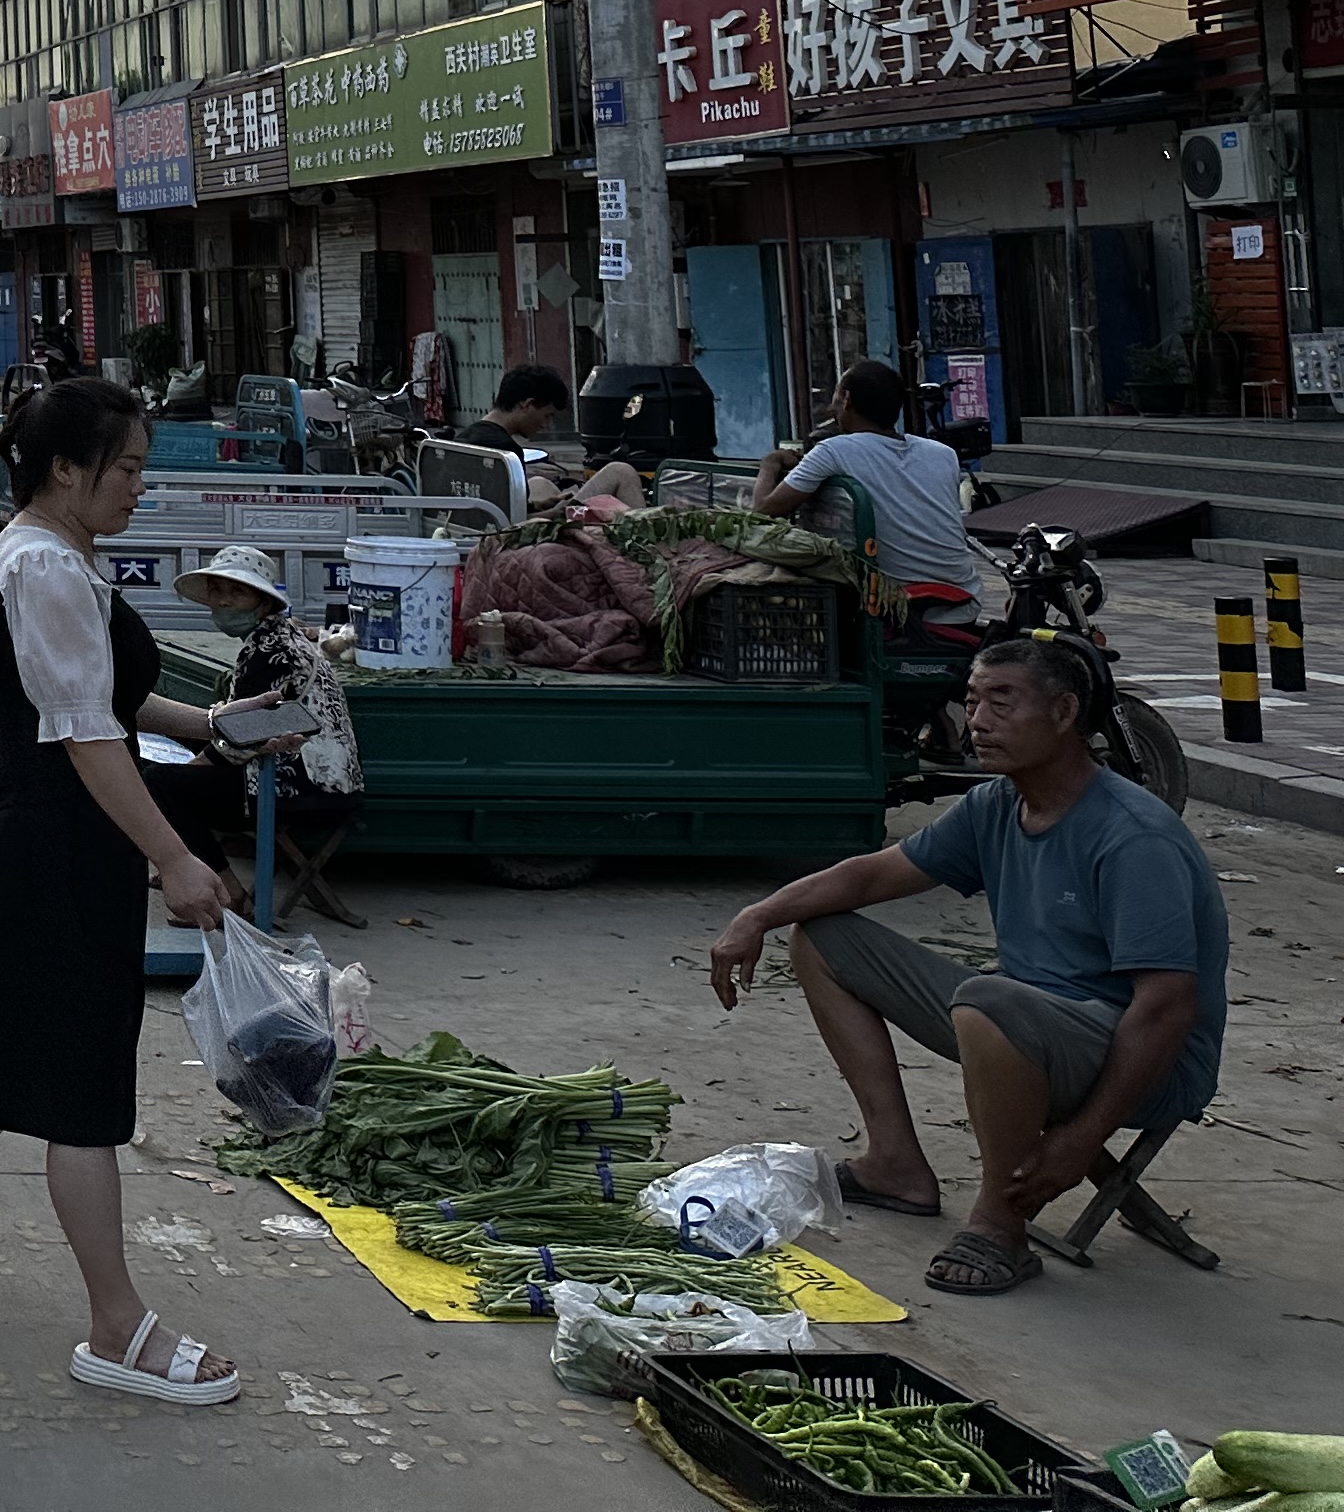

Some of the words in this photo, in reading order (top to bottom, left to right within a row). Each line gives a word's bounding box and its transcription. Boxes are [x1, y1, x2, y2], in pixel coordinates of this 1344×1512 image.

[657, 9, 758, 103] 卡丘
[203, 86, 280, 161] 学生用品
[701, 97, 761, 124] Pikachu
[54, 122, 112, 178] 推拿点穴
[223, 167, 237, 187] 文具
[1237, 235, 1261, 252] 打印
